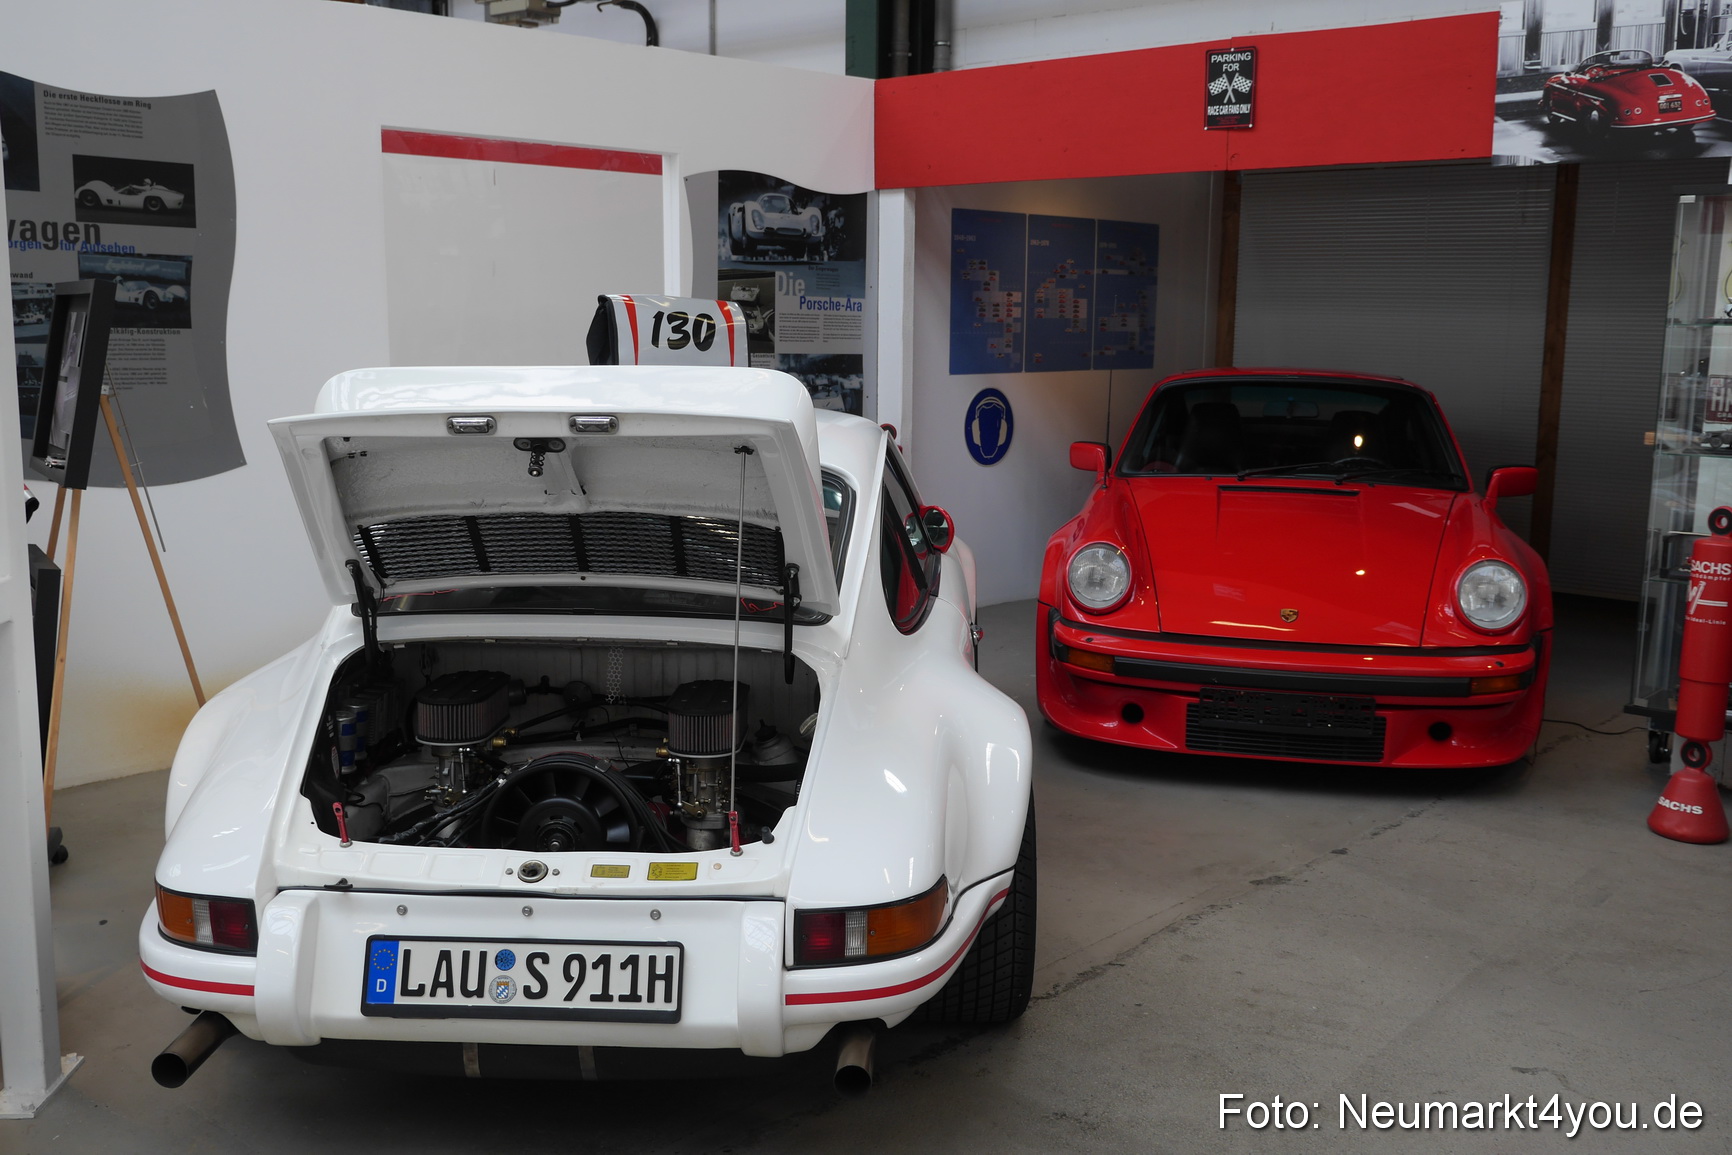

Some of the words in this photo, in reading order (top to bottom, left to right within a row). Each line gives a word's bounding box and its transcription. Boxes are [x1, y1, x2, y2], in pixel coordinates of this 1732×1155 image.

[1211, 52, 1252, 63] PARKING
[1222, 63, 1240, 72] FOR
[43, 90, 57, 98] Die
[58, 92, 78, 101] erste
[79, 94, 121, 105] Heckflosse
[135, 100, 152, 110] Ring
[1207, 105, 1219, 116] RACE
[1219, 104, 1228, 115] CAR
[1228, 104, 1240, 115] FANS
[1239, 103, 1252, 114] ONLY
[80, 241, 136, 254] Aufsehen
[777, 271, 806, 296] Die
[799, 293, 862, 312] Porsche-Ära
[651, 310, 716, 352] 130
[1690, 559, 1732, 576] SACHS
[1657, 796, 1704, 815] SACHS
[400, 948, 488, 999] LAU
[522, 951, 550, 1000] S
[562, 953, 674, 1003] 911H
[375, 979, 386, 993] D
